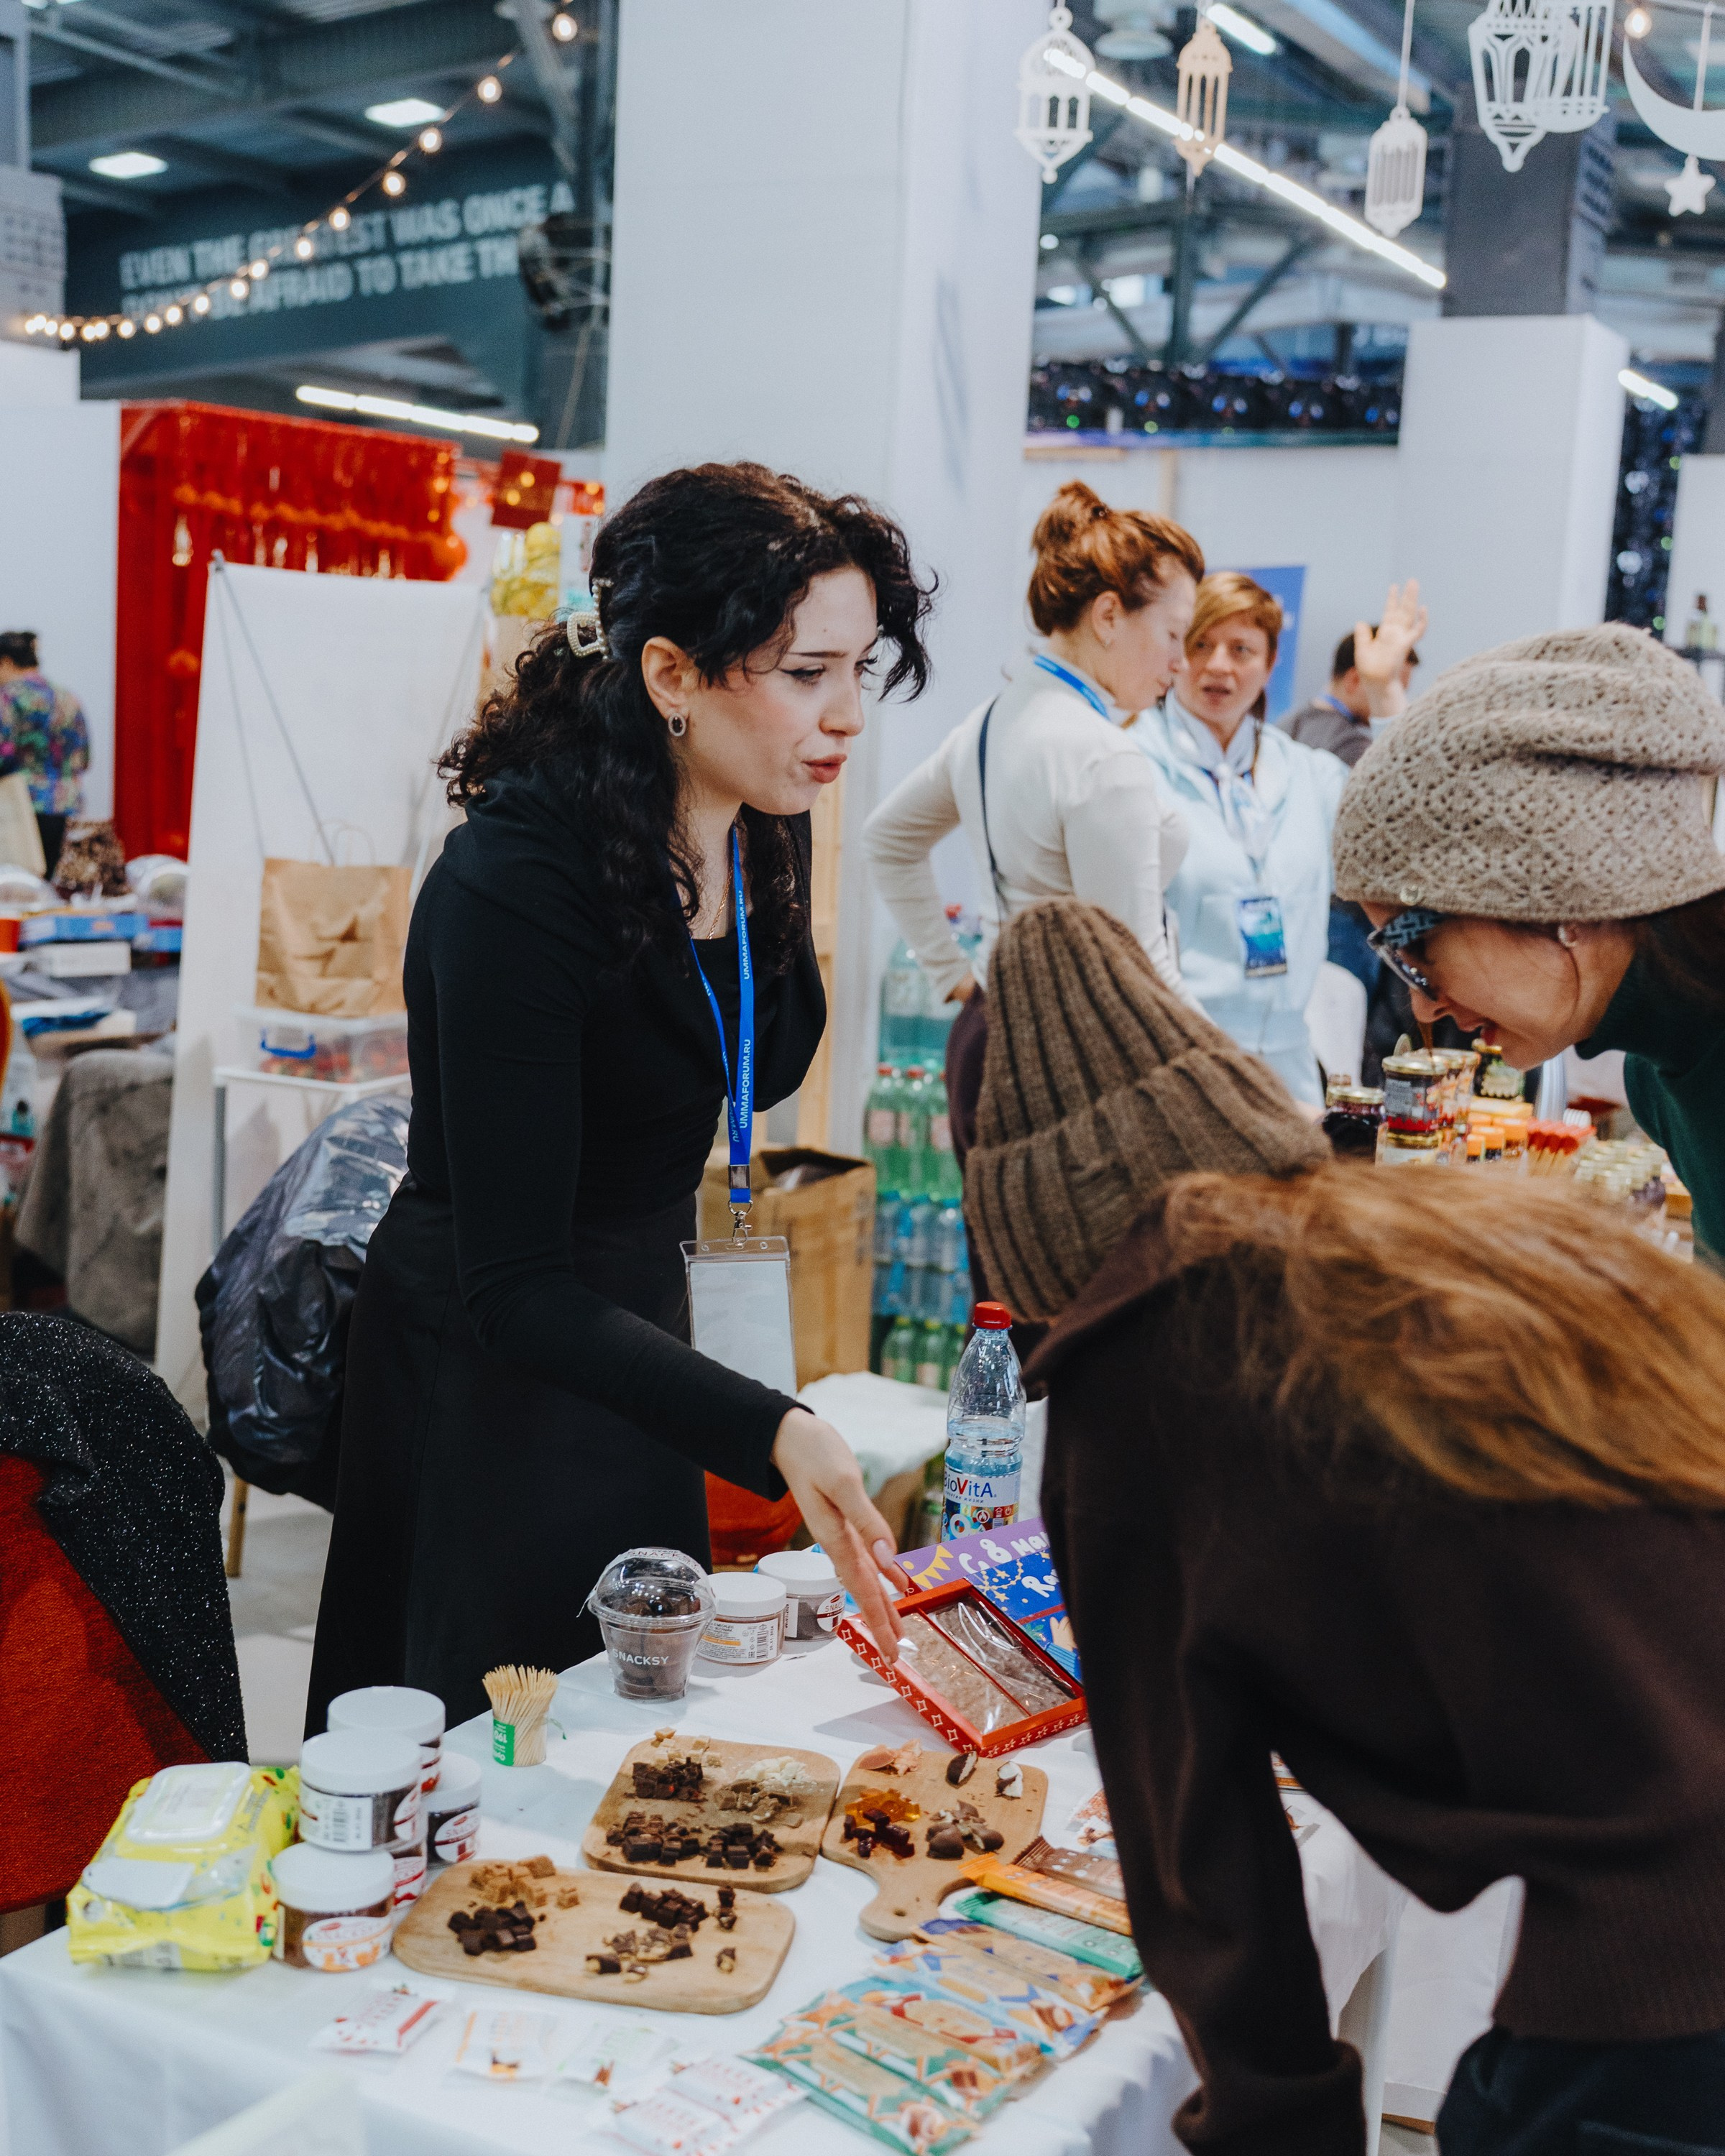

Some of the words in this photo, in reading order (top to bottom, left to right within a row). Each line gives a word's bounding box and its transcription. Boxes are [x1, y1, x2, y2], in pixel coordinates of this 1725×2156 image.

[193, 233, 246, 279] THE
[390, 197, 460, 247] WAS
[463, 183, 546, 236] ONCE
[354, 252, 396, 298] TO
[397, 241, 474, 291] TAKE
[736, 890, 750, 980] UMMAFORUM.RU
[740, 1038, 752, 1130] UMMAFORUM.RU
[979, 1538, 1012, 1564] 8
[612, 1648, 669, 1665] SNACKSY
